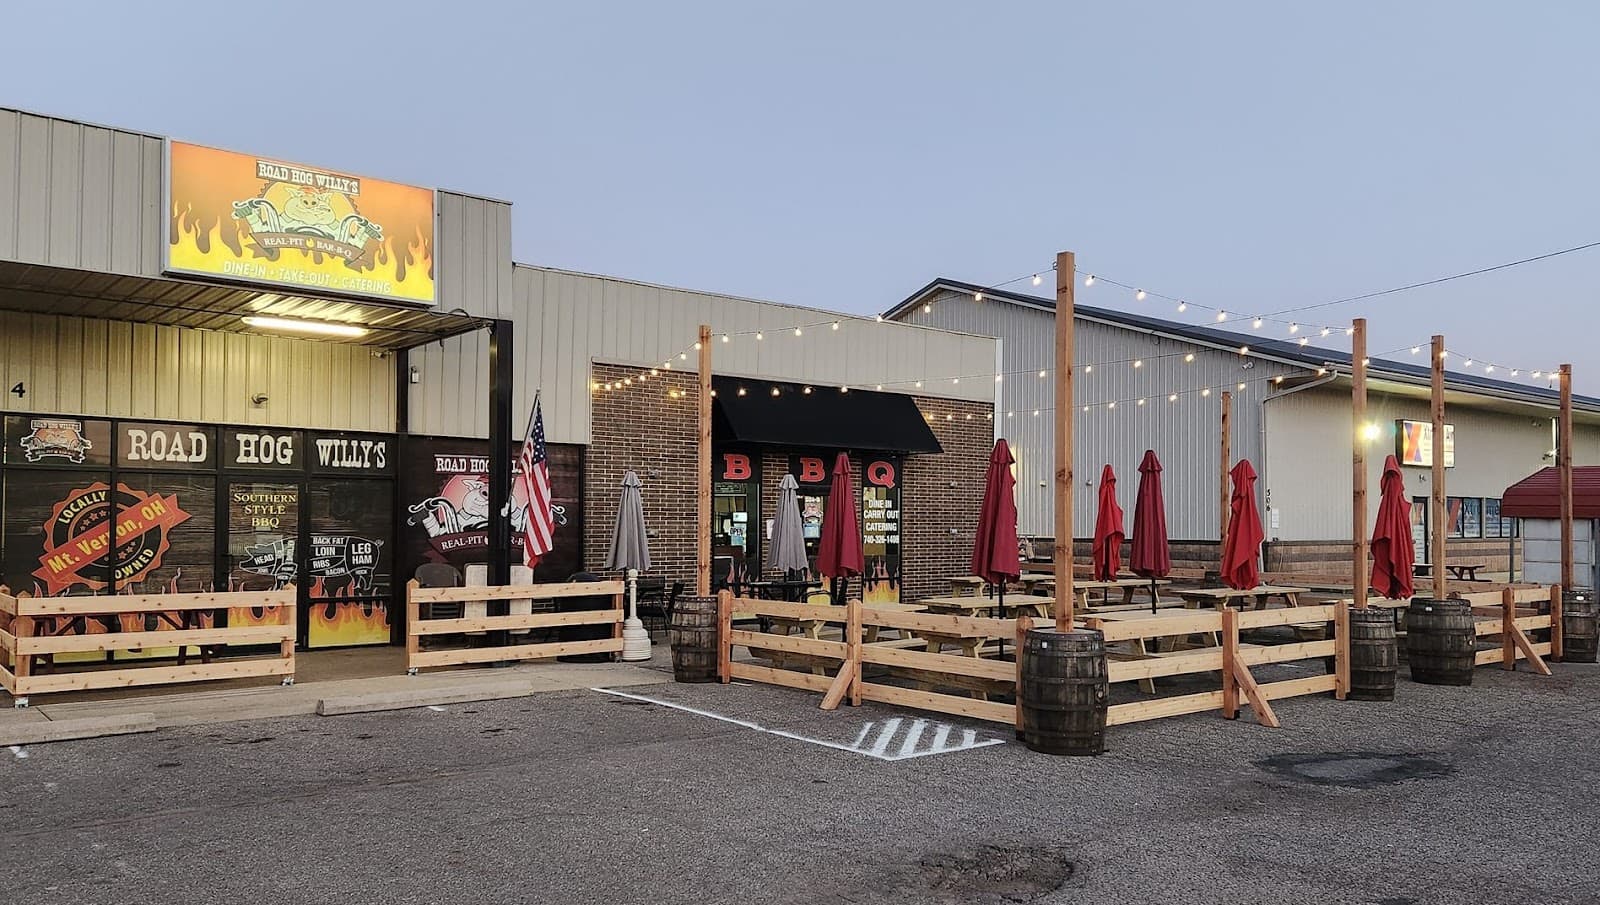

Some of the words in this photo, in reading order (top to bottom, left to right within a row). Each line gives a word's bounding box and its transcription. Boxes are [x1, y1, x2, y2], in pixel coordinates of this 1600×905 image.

[258, 164, 288, 180] ROAD
[291, 170, 313, 186] HOG
[316, 174, 358, 193] WILLY'S
[263, 237, 304, 246] REAL-PIT
[316, 241, 352, 258] BAR-B-Q
[223, 260, 266, 275] DINE-IN
[279, 268, 330, 286] TAKE-OUT
[342, 278, 391, 294] CATERING
[10, 382, 26, 398] 4
[128, 429, 207, 462] ROAD
[236, 433, 294, 464] HOG
[316, 438, 386, 468] WILLY'S
[435, 458, 467, 472] ROAD
[722, 453, 752, 480] B
[800, 458, 826, 482] B
[868, 461, 896, 489] Q
[58, 491, 106, 524] LOCALLY
[244, 504, 286, 514] STYLE
[864, 510, 885, 518] CARRY
[886, 510, 900, 518] OUT
[252, 517, 280, 528] BBQ
[866, 522, 897, 531] CATERING
[48, 552, 80, 574] Mt.
[76, 518, 143, 556] Veron,
[140, 500, 167, 520] OH
[442, 536, 484, 550] REAL-PIT
[315, 546, 336, 556] LOIN
[352, 542, 372, 554] LEG
[115, 548, 154, 580] OWNED
[254, 554, 274, 566] HEAD
[312, 560, 330, 568] RIBS
[352, 555, 372, 564] HAM
[325, 567, 346, 576] BACON
